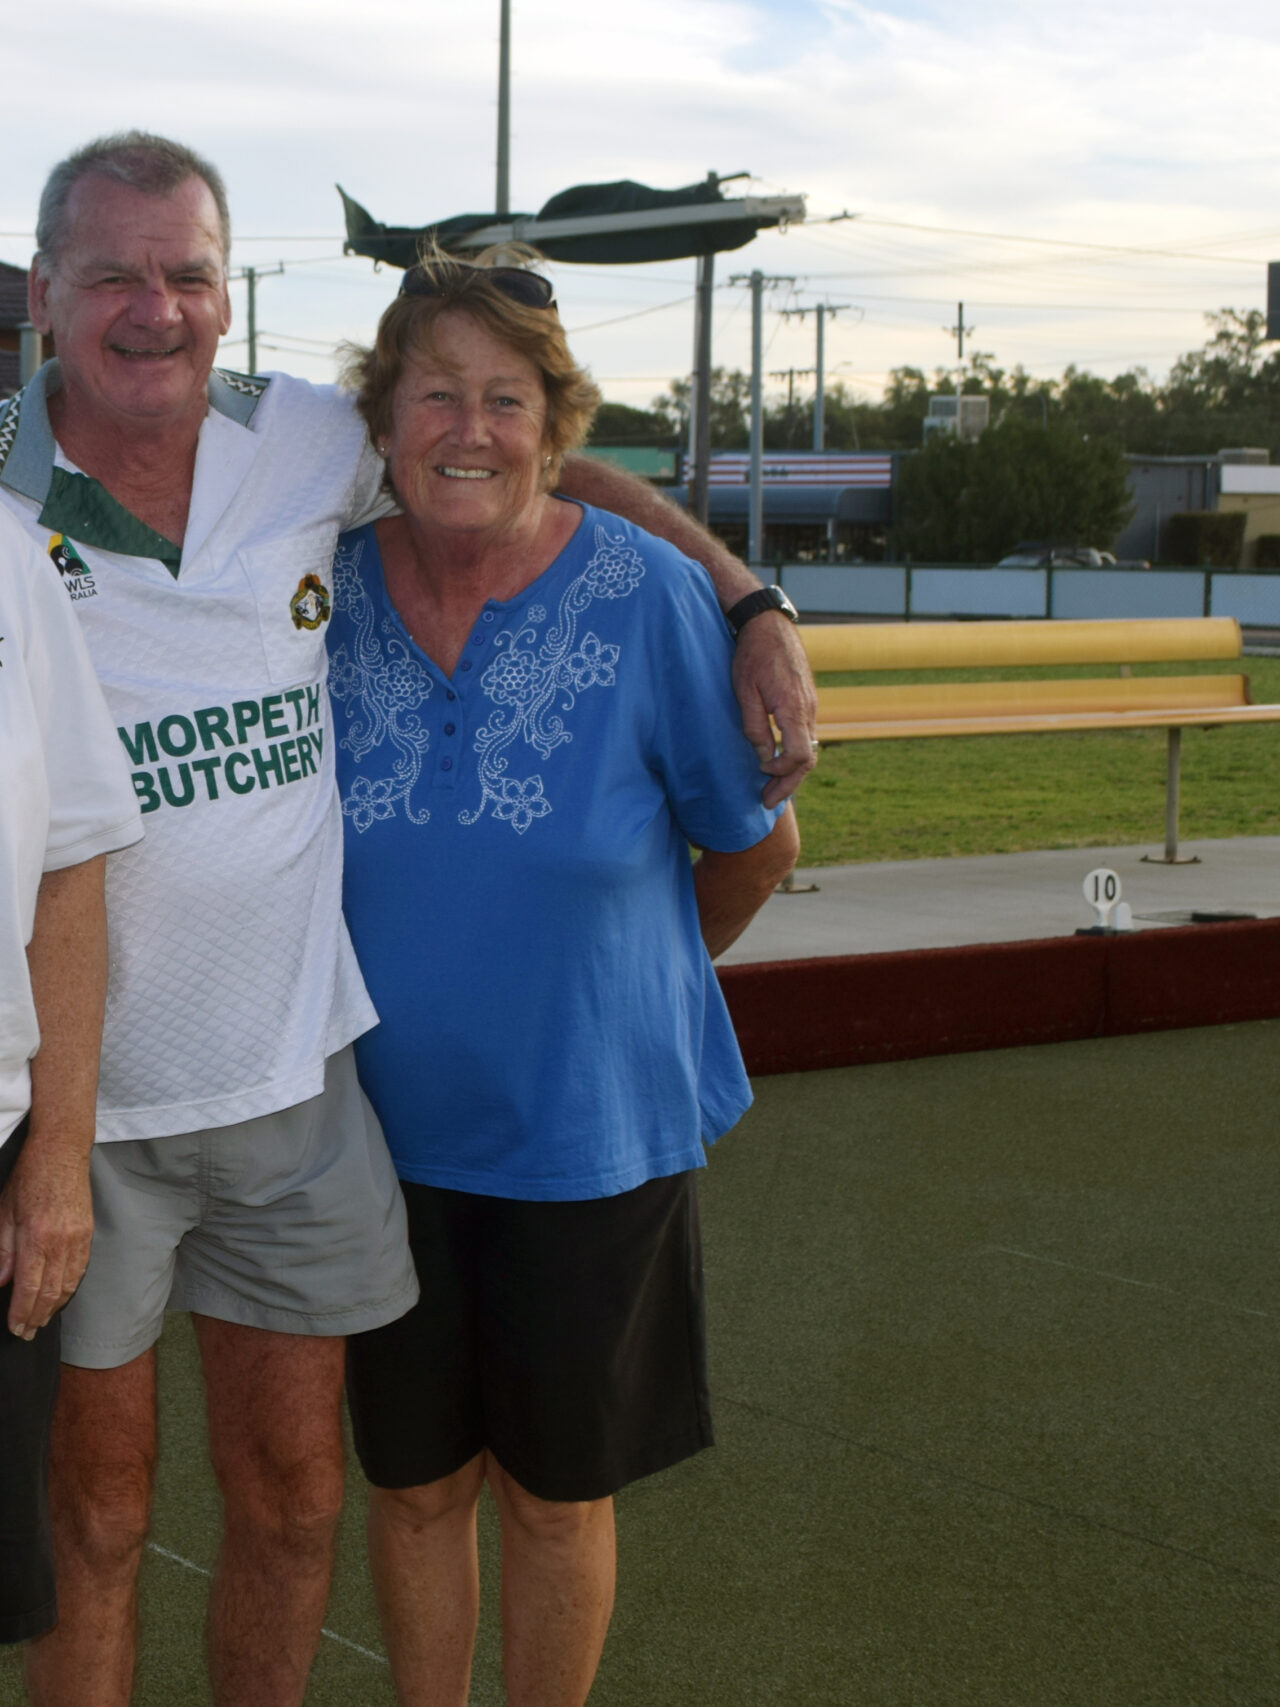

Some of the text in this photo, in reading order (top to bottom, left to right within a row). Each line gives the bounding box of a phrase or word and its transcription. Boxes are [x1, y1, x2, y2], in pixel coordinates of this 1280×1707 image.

[117, 683, 320, 766] MORPETH
[131, 728, 323, 814] BUTCHERY
[1094, 874, 1116, 902] 10
